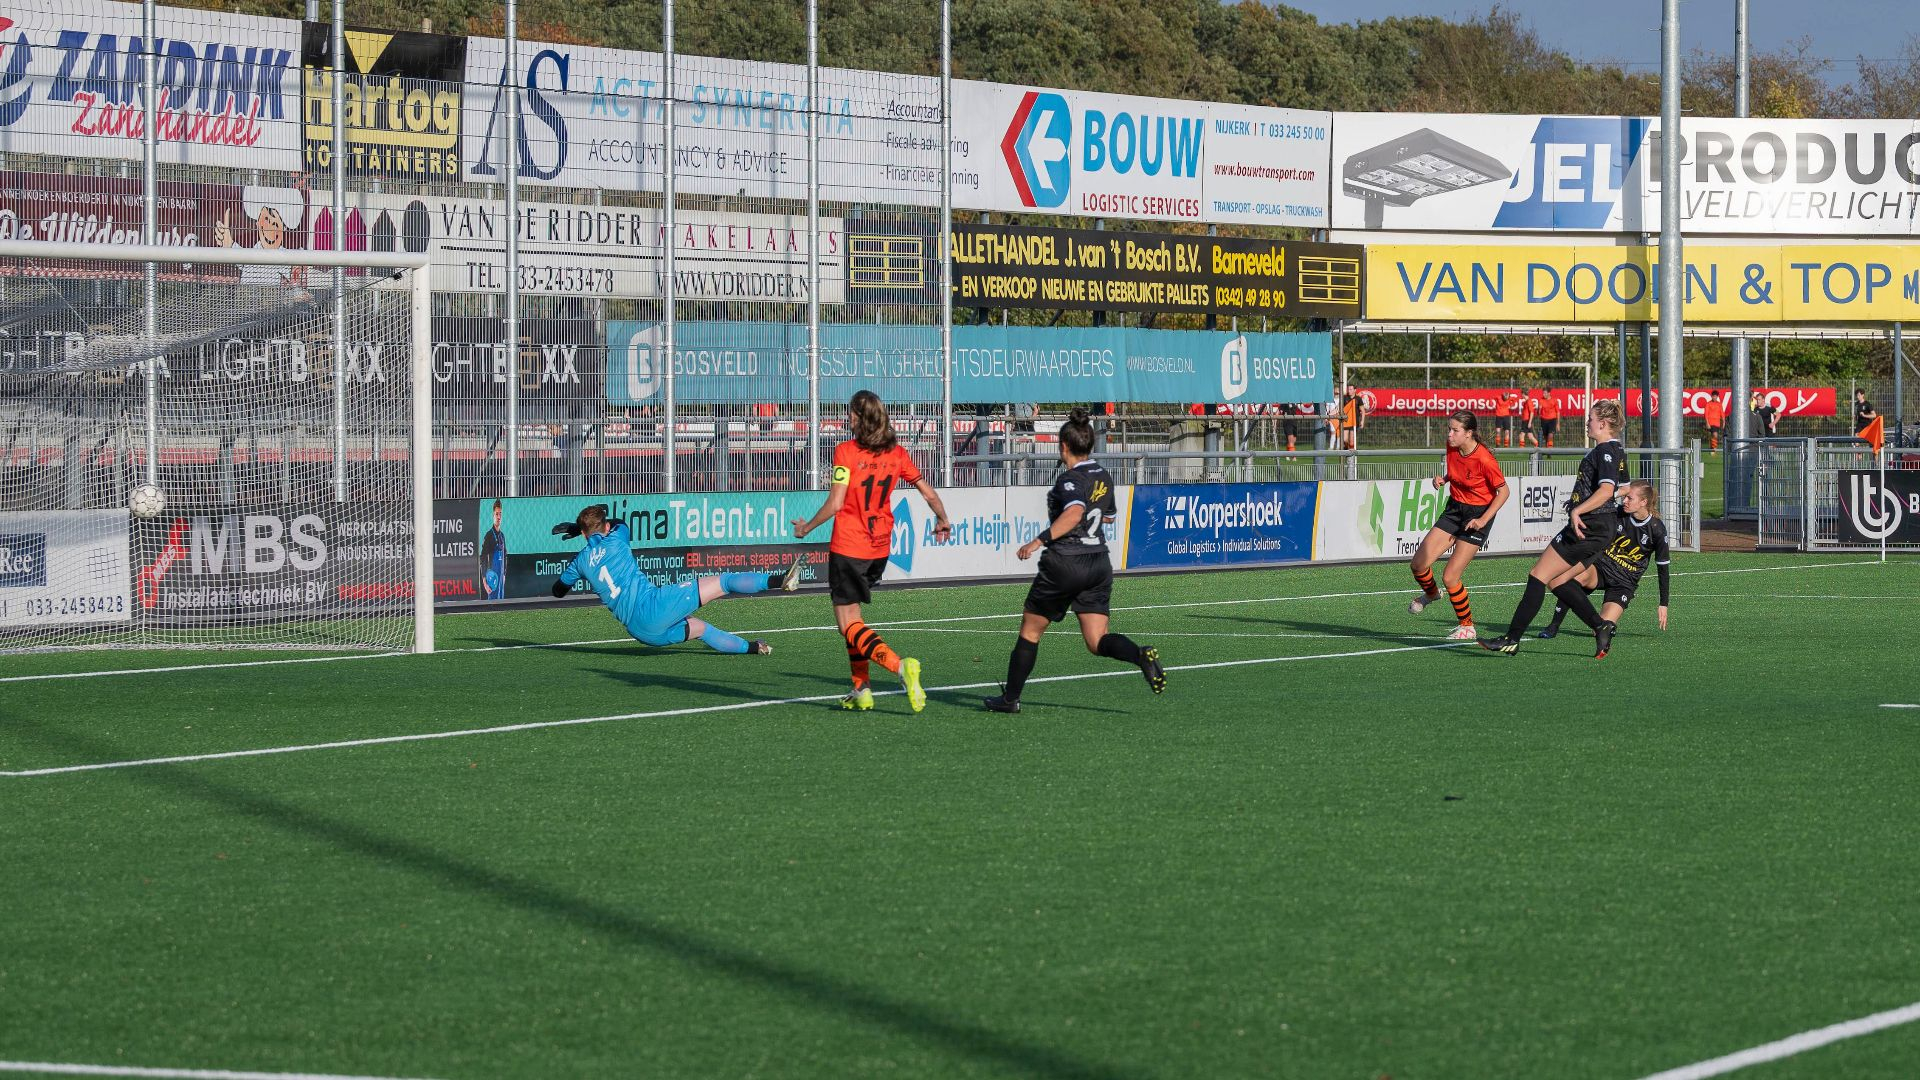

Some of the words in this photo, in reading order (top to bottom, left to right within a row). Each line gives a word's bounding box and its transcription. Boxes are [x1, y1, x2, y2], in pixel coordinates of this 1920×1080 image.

[1083, 109, 1205, 178] BOUW
[1215, 119, 1250, 136] NIJKERK
[1269, 124, 1284, 138] 033
[1286, 126, 1301, 139] 245
[1303, 127, 1313, 139] 50
[1315, 128, 1325, 140] 00
[733, 152, 787, 174] ADVICE
[1214, 162, 1315, 182] www.bouwtransport.com
[1083, 193, 1138, 213] LOGISTIC
[1142, 197, 1199, 217] SERVICES
[1213, 201, 1251, 213] TRANSPORT
[1255, 203, 1281, 215] OPSLAG
[1286, 205, 1323, 217] TRUCKWASH
[441, 203, 496, 238] VAN
[548, 208, 642, 246] RIDDER
[1126, 240, 1171, 272] Bosch
[1176, 243, 1202, 273] B.V.
[1212, 245, 1285, 277] Barneveld
[517, 264, 613, 293] 33-2453478
[962, 276, 978, 298] EN
[981, 276, 1037, 300] VERKOOP
[1041, 277, 1086, 301] NIEUWE
[1088, 280, 1104, 302] EN
[1106, 280, 1165, 304] GEBRUIKTE
[1166, 284, 1210, 306] PALLETS
[1215, 285, 1243, 308] (0342)
[1245, 288, 1256, 305] 49
[1259, 289, 1271, 307] 28
[1273, 290, 1286, 309] 90
[1397, 261, 1503, 304] VAN
[1739, 263, 1774, 305] &
[1791, 262, 1892, 304] TOP
[1254, 357, 1316, 380] BOSVELD
[1387, 394, 1497, 415] Jeugdsponso
[861, 475, 893, 511] 11
[1080, 507, 1101, 545] 2
[1189, 491, 1283, 538] Korpershoek
[192, 513, 327, 574] MBS
[973, 513, 1010, 551] Heijn
[1015, 515, 1040, 545] Van
[1168, 539, 1187, 555] Global
[1190, 541, 1216, 558] Logistics
[1222, 537, 1252, 552] Individual
[1254, 536, 1281, 550] Solutions
[751, 552, 780, 569] stages
[305, 581, 326, 602] BV
[598, 565, 621, 599] 1
